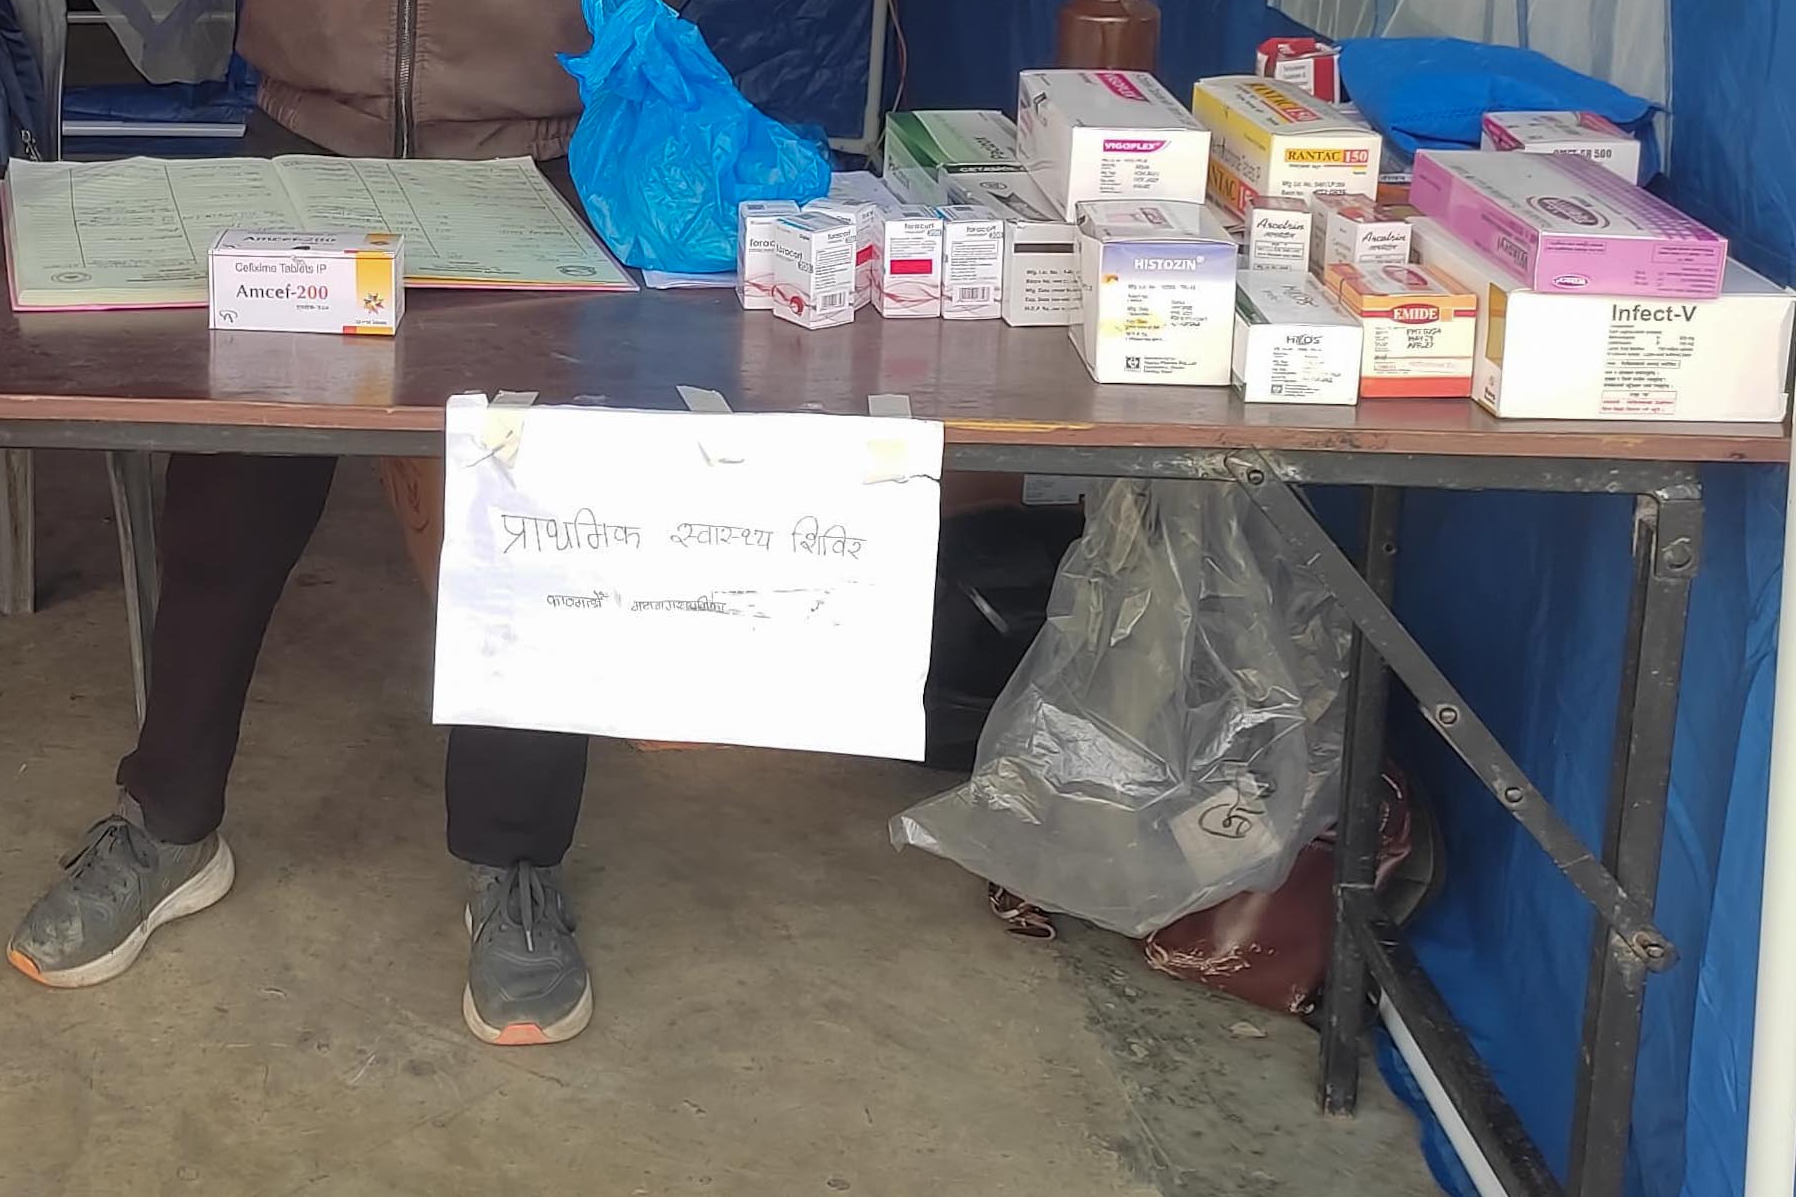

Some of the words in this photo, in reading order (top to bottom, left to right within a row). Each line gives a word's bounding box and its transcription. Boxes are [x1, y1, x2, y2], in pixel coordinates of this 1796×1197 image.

[1104, 142, 1154, 151] VIGOFLEX
[1287, 150, 1340, 162] RANTAC
[1345, 150, 1368, 163] 150
[1594, 148, 1613, 159] 500
[749, 238, 775, 248] forac
[235, 262, 277, 273] Cefixime
[280, 262, 314, 274] Tablets
[316, 263, 328, 274] IP
[236, 283, 328, 300] Amcef-200
[1393, 307, 1439, 320] EMIDE
[1611, 303, 1698, 322] Infect-V
[501, 507, 641, 554] प्राथमिक
